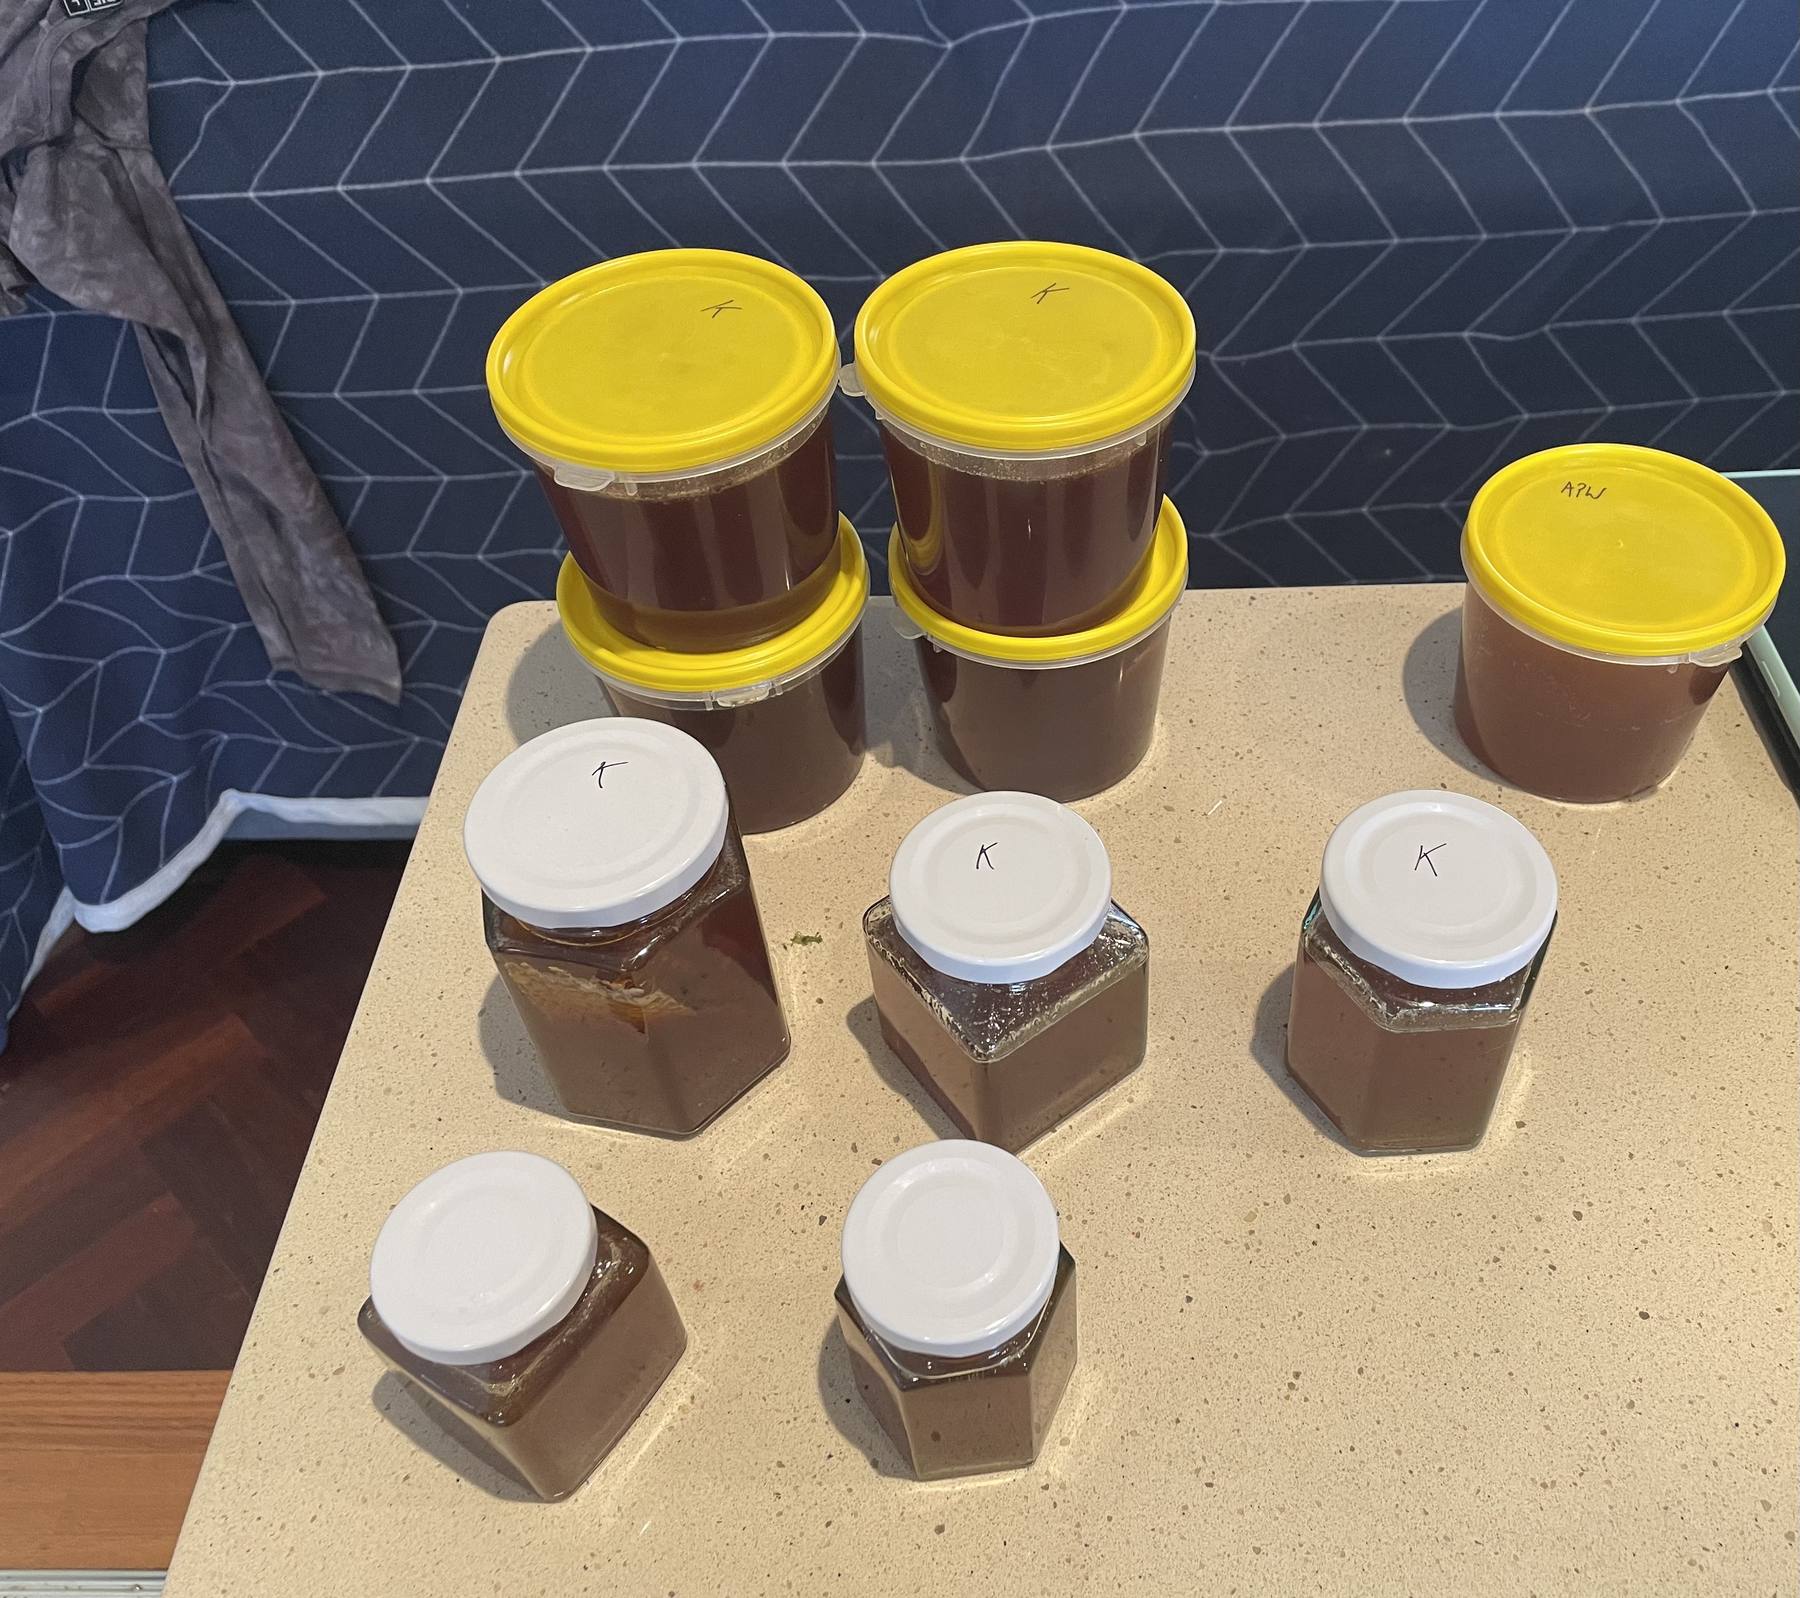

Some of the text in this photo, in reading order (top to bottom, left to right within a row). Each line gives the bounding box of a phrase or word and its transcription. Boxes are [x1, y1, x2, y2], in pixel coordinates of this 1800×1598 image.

[1030, 282, 1070, 304] K
[700, 299, 743, 319] K
[1560, 480, 1607, 500] APW
[975, 841, 999, 870] K
[1414, 844, 1448, 877] K
